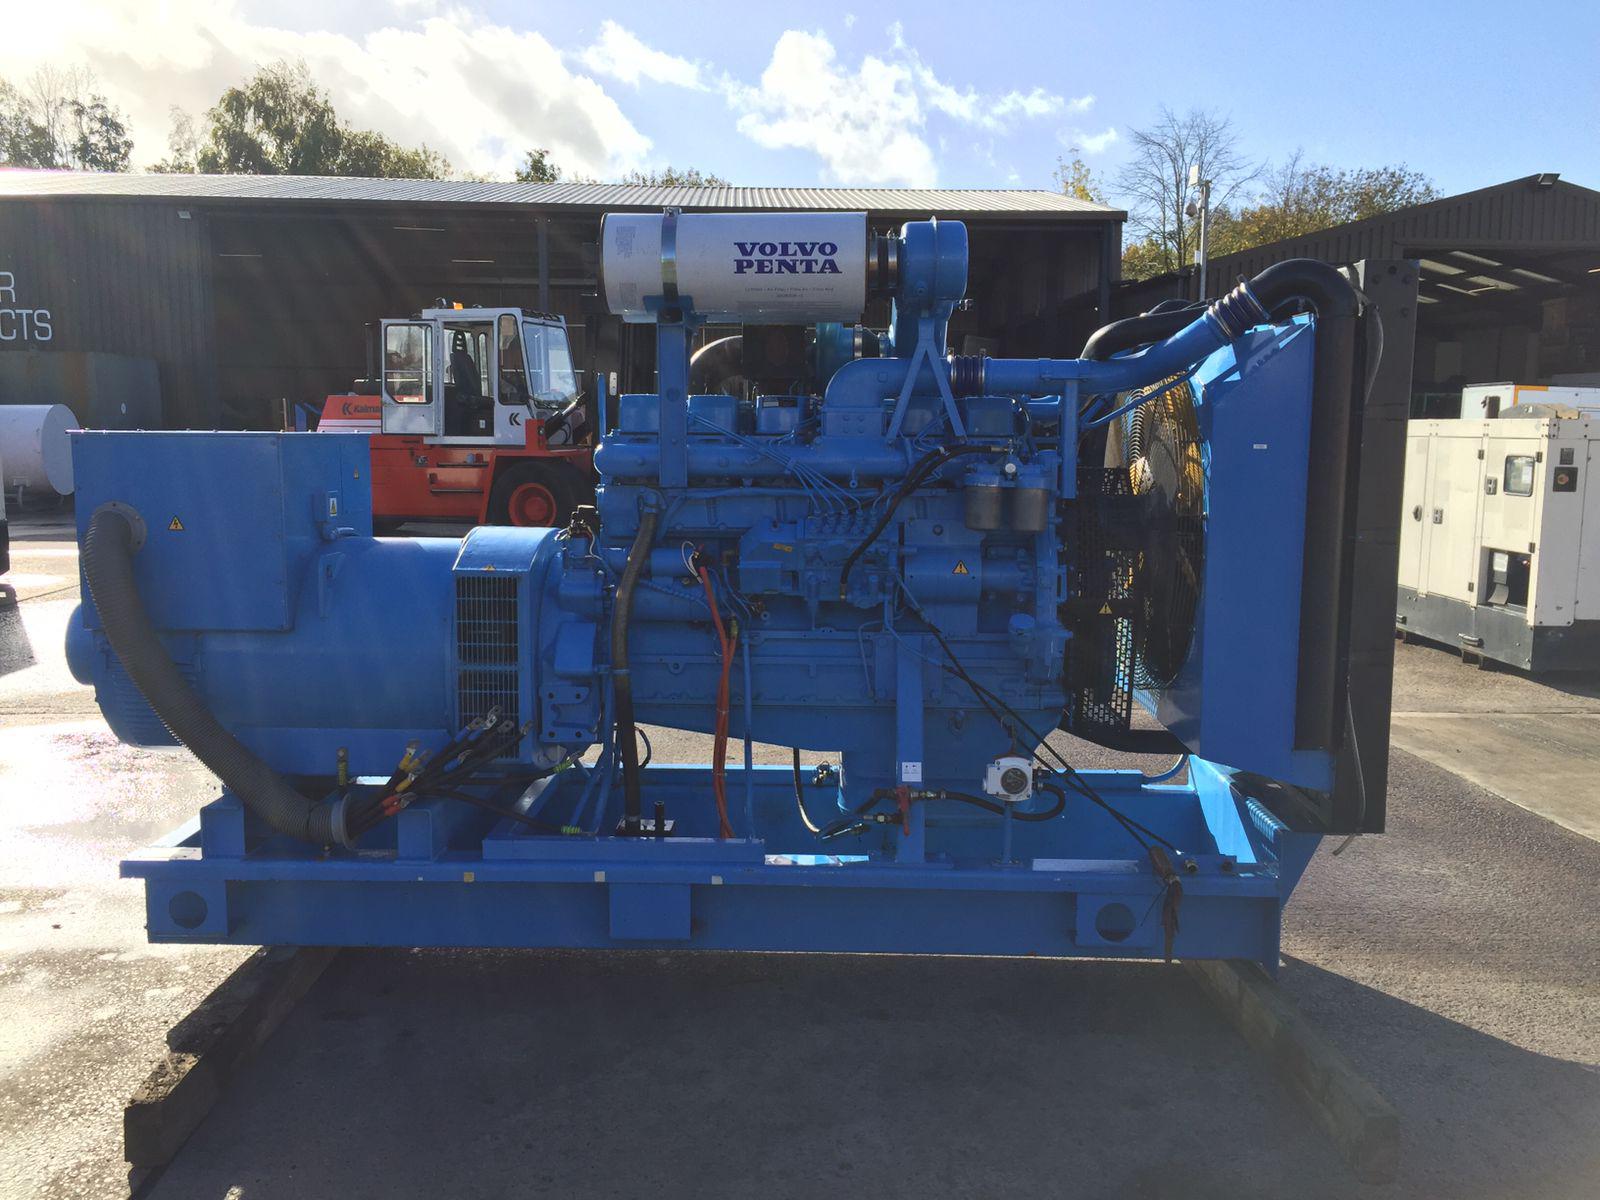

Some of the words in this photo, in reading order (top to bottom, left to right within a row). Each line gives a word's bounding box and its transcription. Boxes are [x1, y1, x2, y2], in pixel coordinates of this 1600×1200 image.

[734, 242, 838, 257] VOLVO
[734, 259, 842, 274] PENTA
[0, 271, 16, 303] R
[0, 309, 52, 341] CTS
